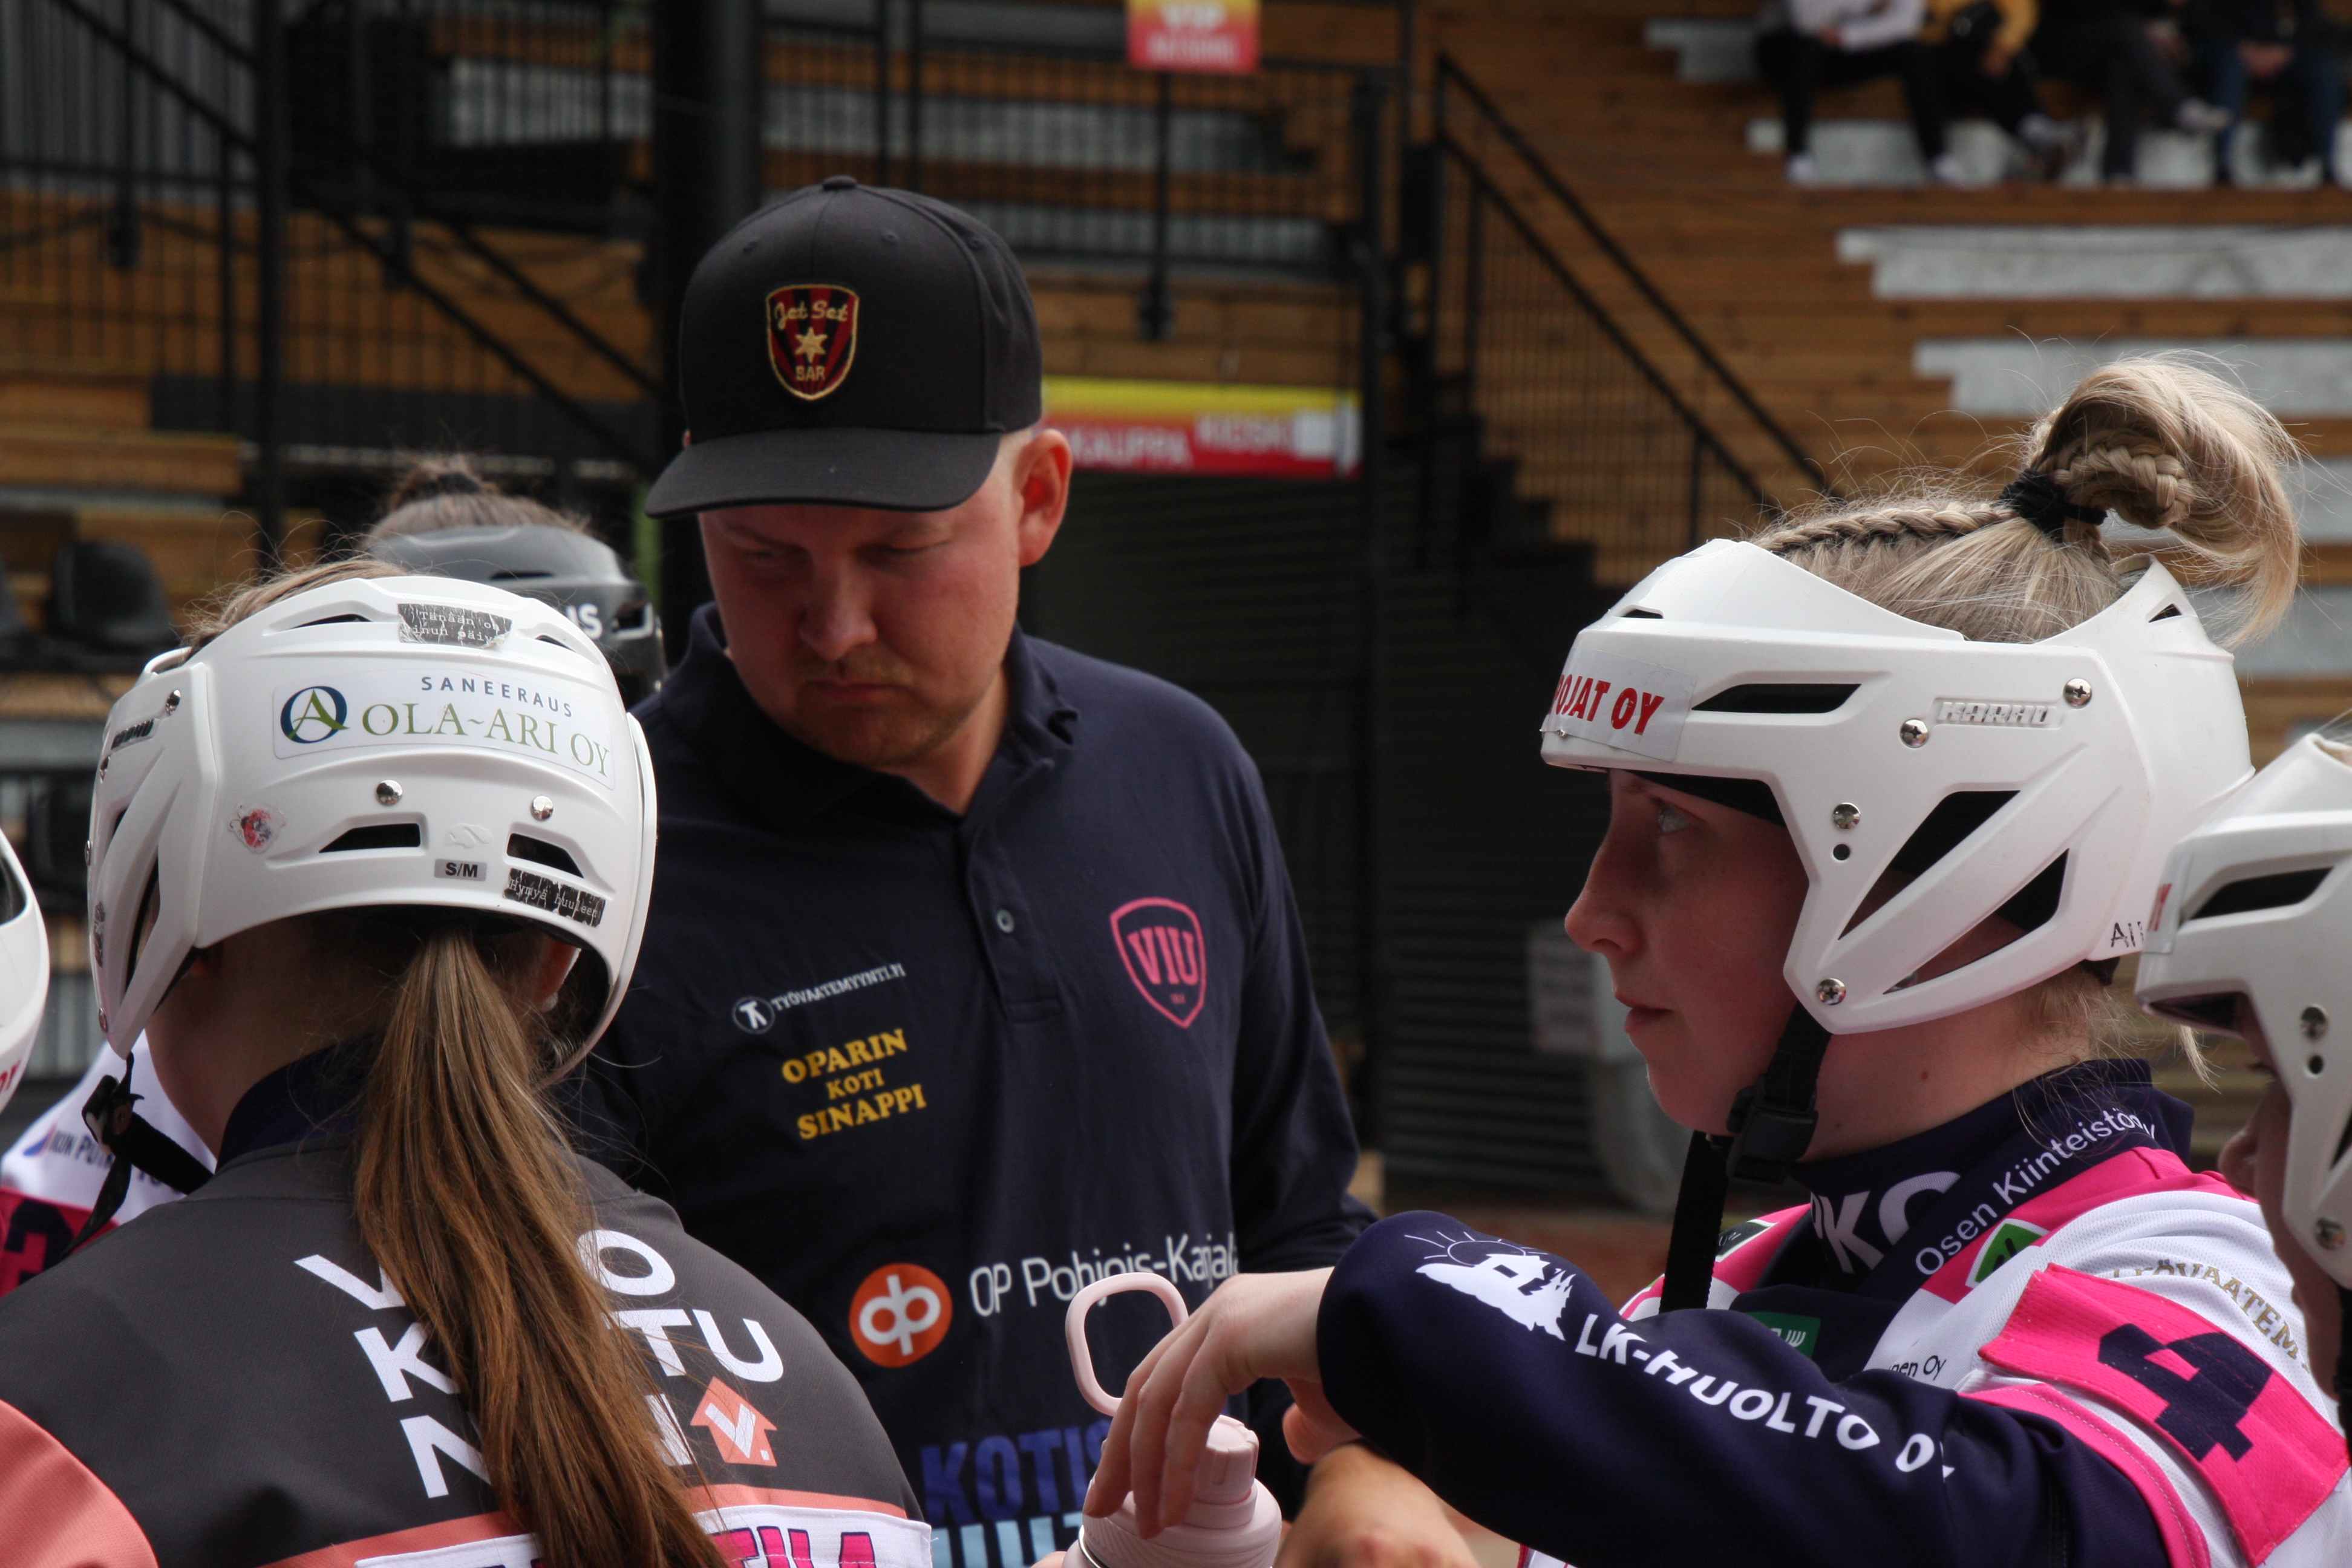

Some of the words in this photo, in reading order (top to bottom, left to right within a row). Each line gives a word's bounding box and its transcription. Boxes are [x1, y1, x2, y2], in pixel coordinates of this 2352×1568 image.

[774, 302, 808, 330] Jet
[811, 300, 849, 322] Set
[413, 624, 448, 636] inun
[458, 630, 493, 645] päiv
[420, 676, 573, 718] SANEERAUS
[1610, 687, 1665, 736] OY
[1937, 701, 2057, 725] KARHU
[570, 732, 610, 778] OY
[445, 861, 479, 878] S/M
[782, 1028, 909, 1084] OPARIN
[826, 1068, 886, 1100] KOTI
[797, 1083, 927, 1140] SINAPPI
[1915, 1203, 1998, 1276] Osen
[969, 1263, 1013, 1318] OP
[1574, 1314, 1881, 1451] LK-HUOLTO
[1922, 1354, 1947, 1381] Oy
